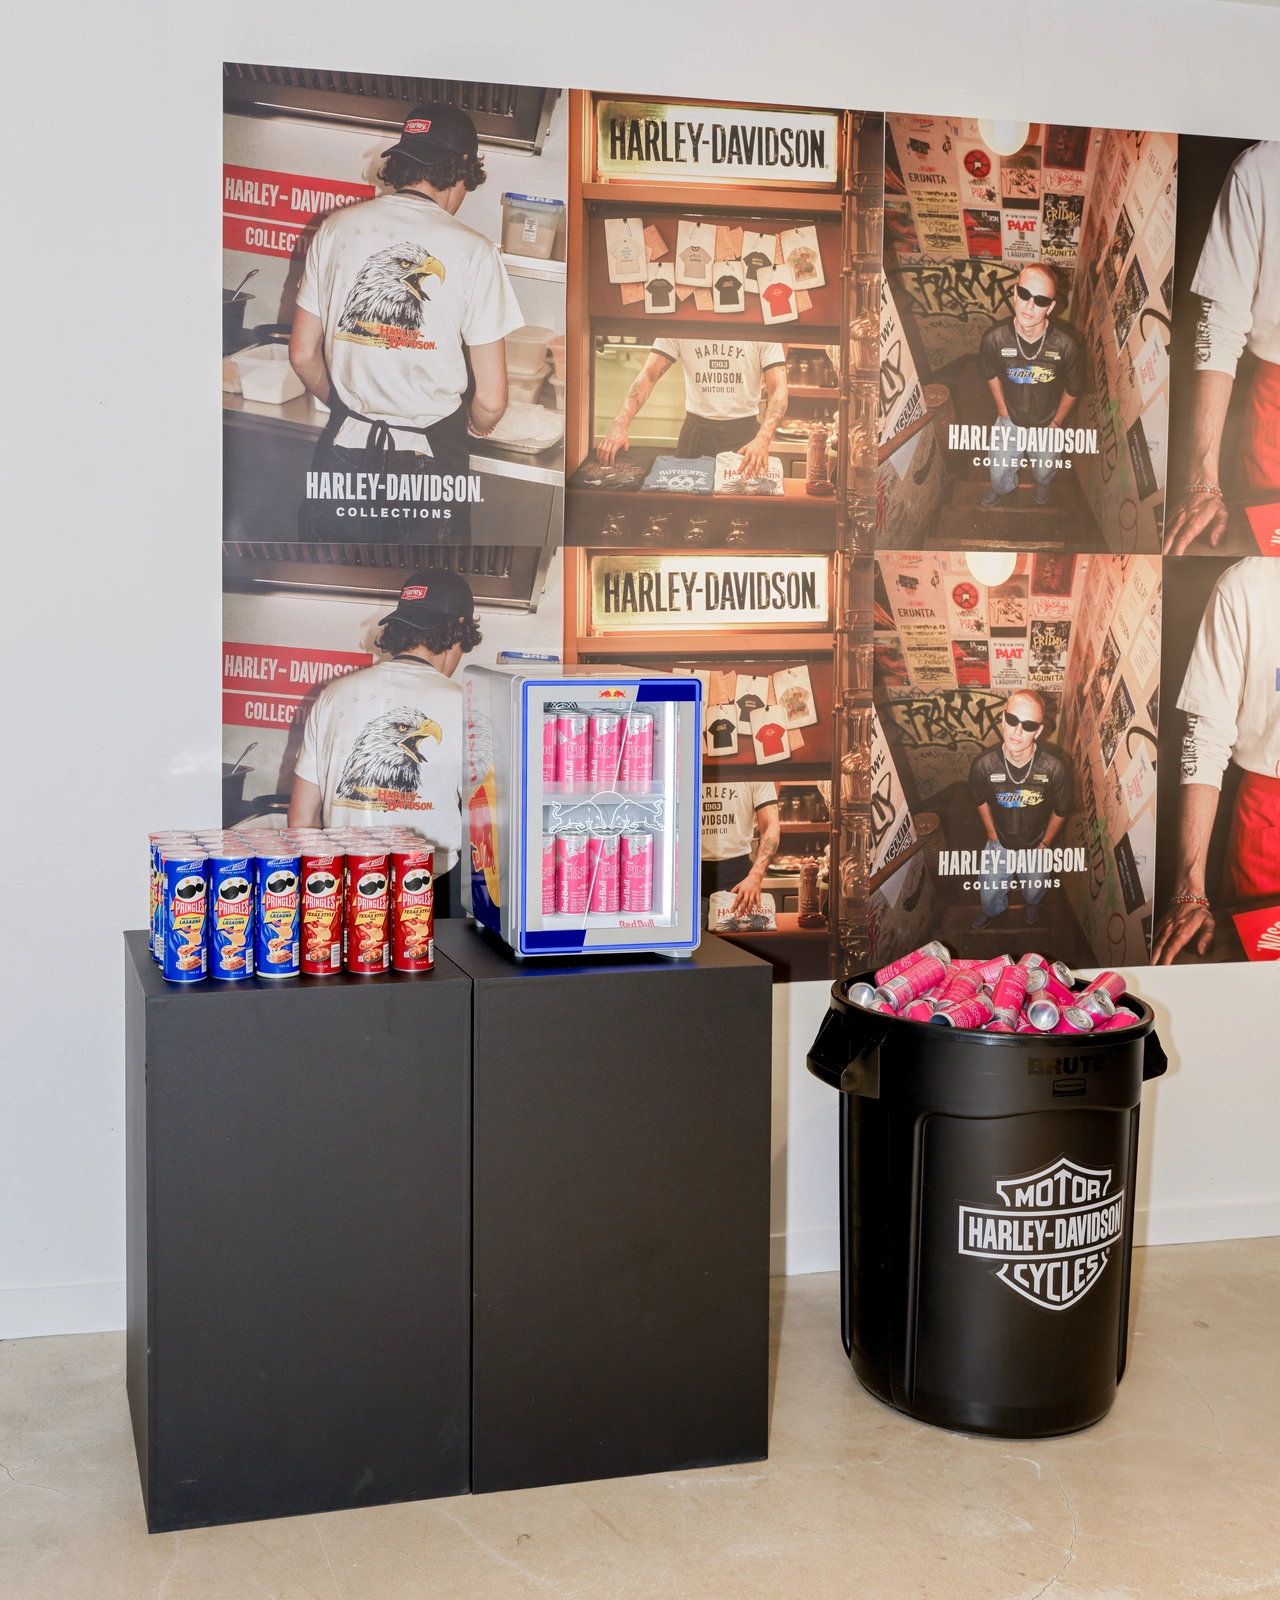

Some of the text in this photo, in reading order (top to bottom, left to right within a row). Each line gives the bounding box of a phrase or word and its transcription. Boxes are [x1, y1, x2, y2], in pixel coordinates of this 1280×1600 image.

[609, 117, 825, 169] HARLEY-DAVIDSON
[1046, 209, 1081, 223] FRIDAY
[1007, 220, 1037, 232] PAAT
[973, 457, 1073, 469] COLLECTIONS
[336, 507, 452, 519] COLLECTIONS
[604, 571, 816, 613] HARLEY-DAVIDSON
[1033, 635, 1067, 649] FRIDAY
[995, 648, 1024, 659] PAAT
[568, 745, 588, 755] PIN
[704, 803, 721, 811] 1903
[702, 814, 736, 826] VIDSON.
[601, 865, 620, 875] PIN
[963, 878, 1061, 891] COLLECTIONS
[266, 892, 296, 908] PRINGLES
[305, 894, 336, 910] PRINGLES
[357, 895, 386, 911] PRINGLES
[402, 891, 431, 907] PRINGLES
[599, 881, 607, 911] Red Bull
[175, 900, 205, 916] PRINGLES
[218, 900, 249, 916] PRINGLES
[619, 919, 655, 928] Red Bull
[1028, 1053, 1105, 1076] BRUTE
[1015, 1169, 1101, 1207] MOTOR
[968, 1201, 1121, 1251] HARLEY-DAVIDSON
[1014, 1254, 1099, 1302] CYCLES
